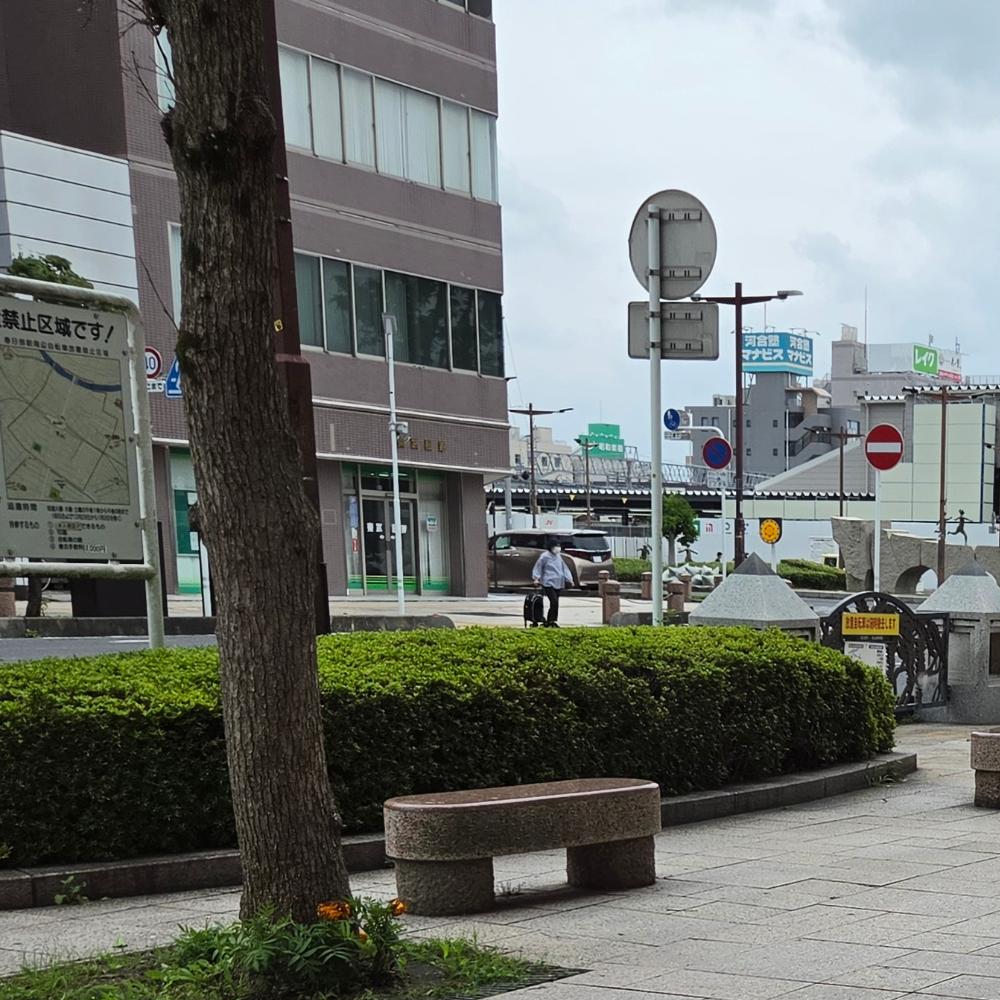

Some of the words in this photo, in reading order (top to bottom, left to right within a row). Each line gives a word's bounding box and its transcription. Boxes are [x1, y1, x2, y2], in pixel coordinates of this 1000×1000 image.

[0, 308, 114, 344] 禁止区域です!
[744, 335, 780, 347] 河合塾
[789, 335, 810, 352] 河合塾
[742, 348, 784, 360] マナビス
[787, 349, 812, 365] マナビス
[915, 348, 935, 368] レイク
